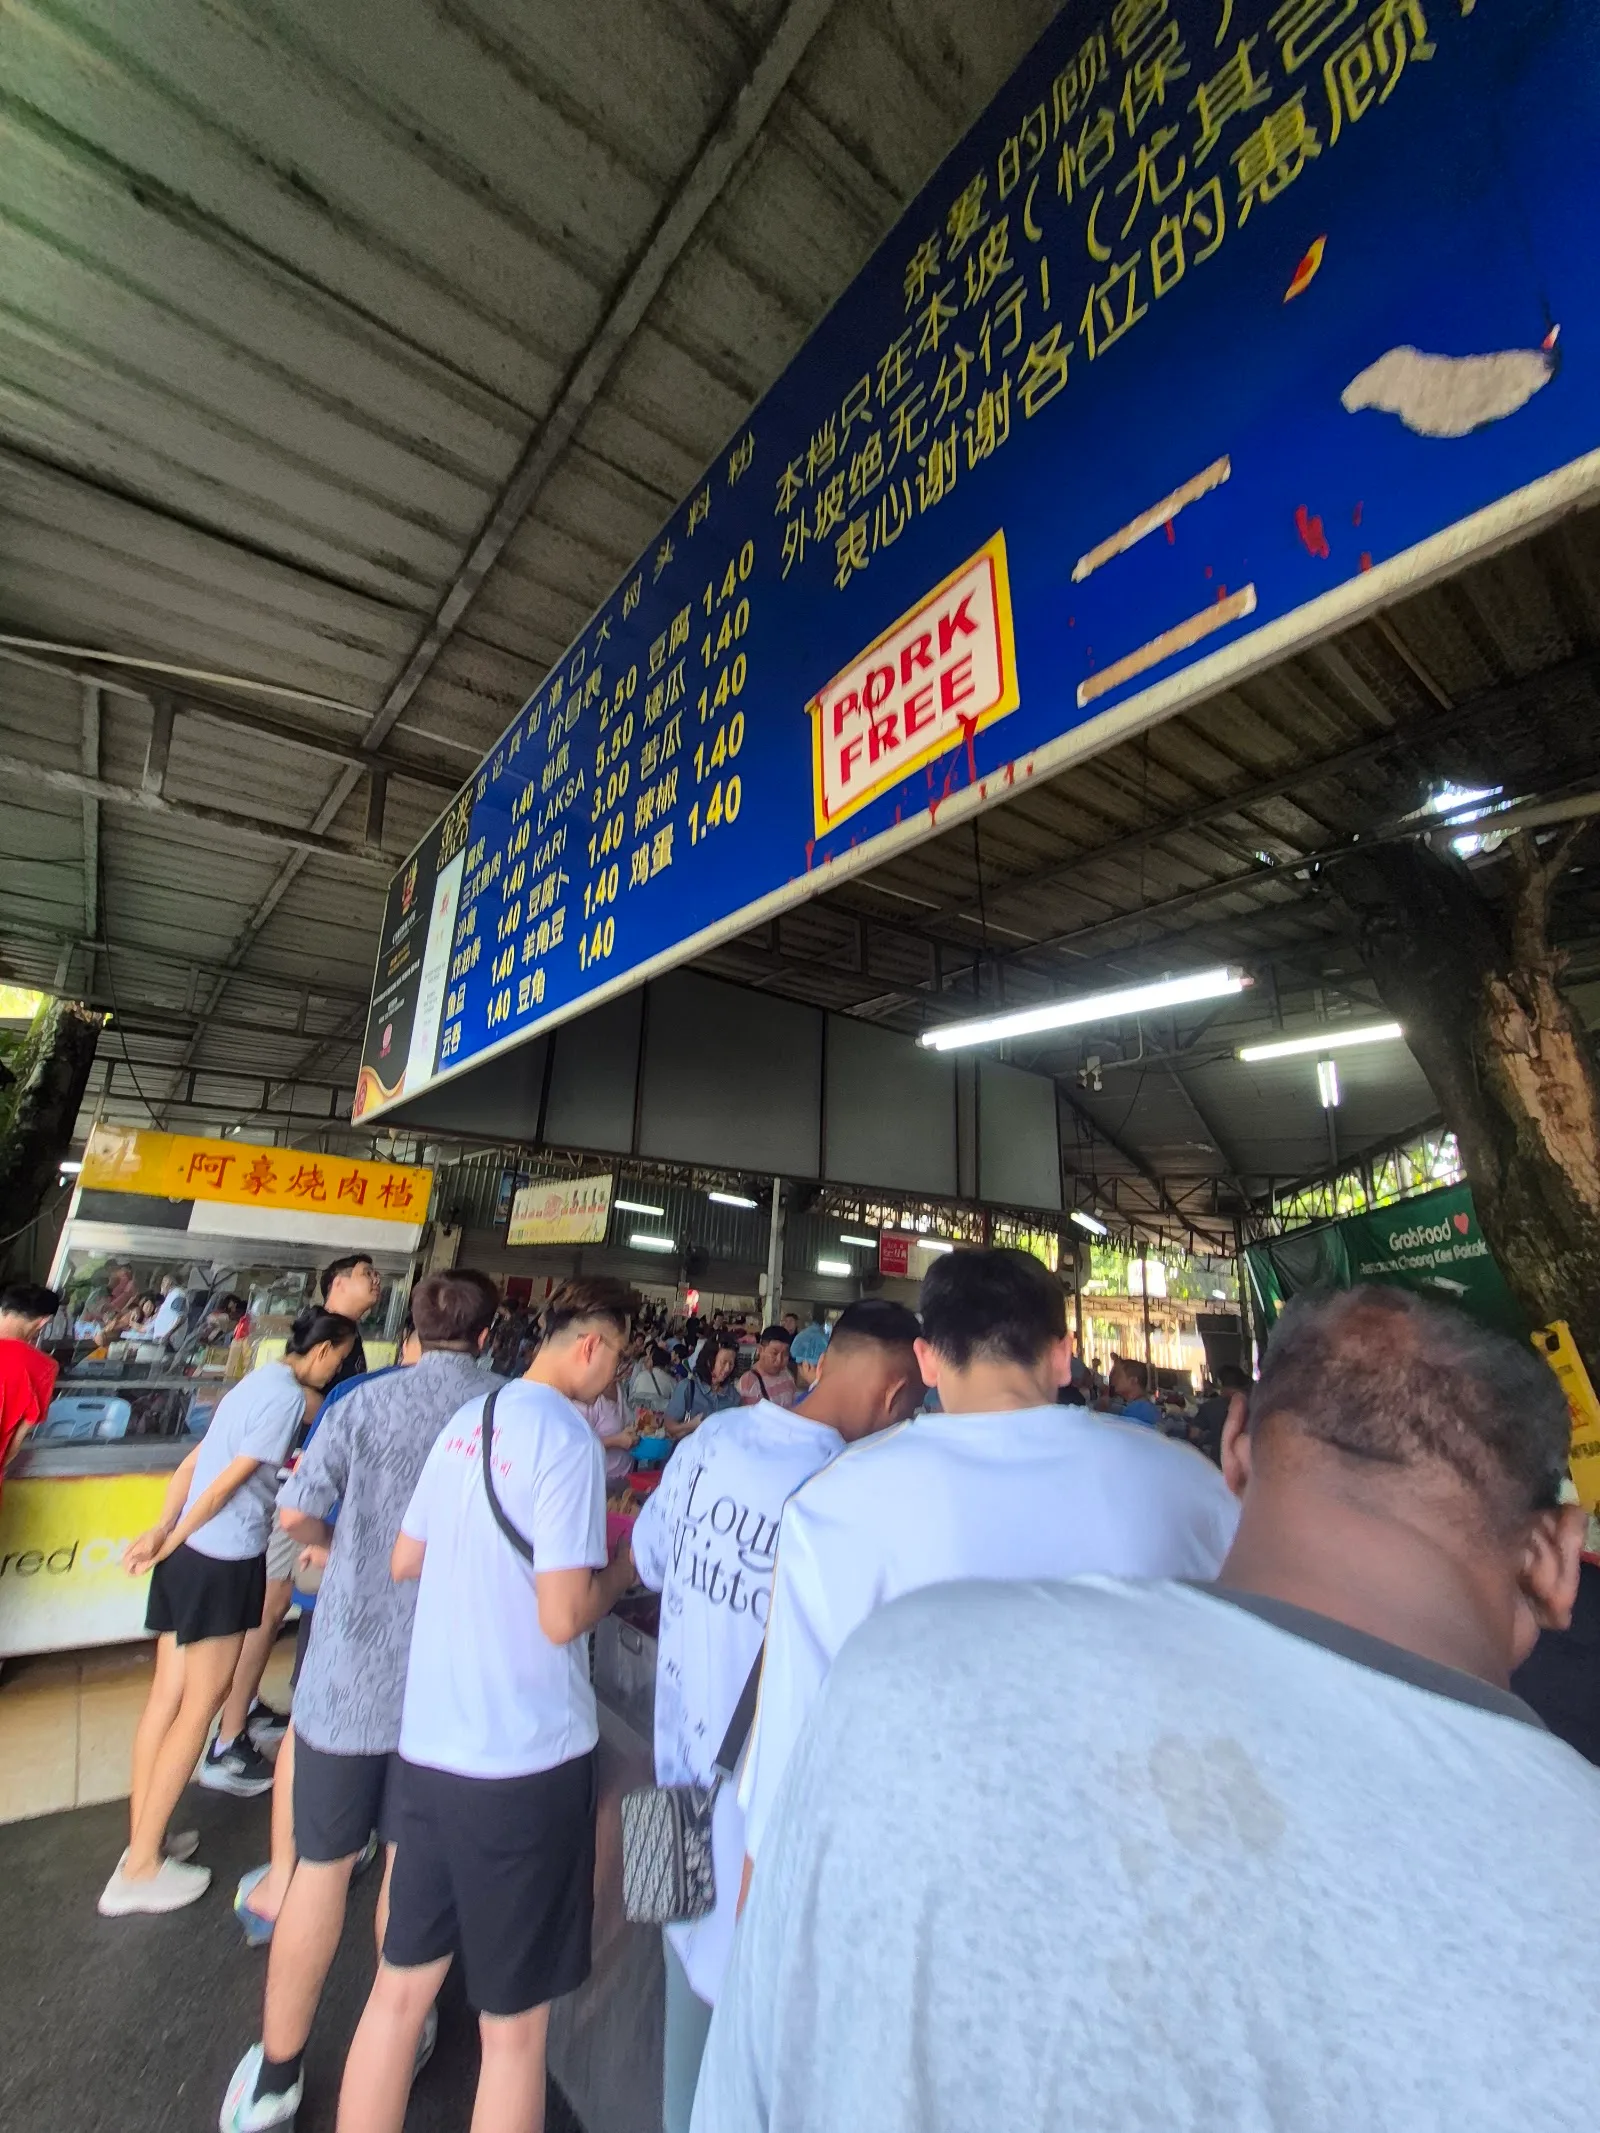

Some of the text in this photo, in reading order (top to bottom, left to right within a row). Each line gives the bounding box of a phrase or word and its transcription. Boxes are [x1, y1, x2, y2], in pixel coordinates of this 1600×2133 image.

[834, 0, 1477, 592] 衷心谢谢各位的惠顾
[507, 819, 530, 863] 1.40
[537, 768, 586, 836] LAKSA
[595, 711, 633, 778] 5.50
[700, 597, 750, 668] 1.40
[511, 780, 535, 825] 1.40
[600, 664, 637, 734] 2.50
[647, 602, 691, 681] 豆腐
[702, 539, 754, 617] 1.40
[548, 664, 602, 753] 价目表
[832, 585, 980, 739] PORK
[839, 649, 977, 787] FREE
[435, 824, 470, 872] GOLD
[497, 900, 521, 943] 1.40
[526, 866, 570, 923] 豆腐卜
[588, 811, 624, 869] 1.40
[634, 766, 679, 838] 辣椒
[693, 711, 745, 784] 1.40
[502, 860, 526, 903] 1.40
[532, 824, 568, 878] KARI
[591, 760, 630, 823] 3.00
[641, 710, 683, 781] 苦瓜
[697, 652, 747, 724] 1.40
[491, 944, 515, 987] 1.40
[521, 905, 566, 966] 羊角豆
[583, 863, 619, 920] 1.40
[628, 822, 674, 891] 鸡蛋
[687, 774, 742, 848] 1.40
[487, 987, 511, 1030] 1.40
[516, 967, 546, 1015] 豆角
[579, 915, 615, 972] 1.40
[1389, 1217, 1452, 1252] GrabFood
